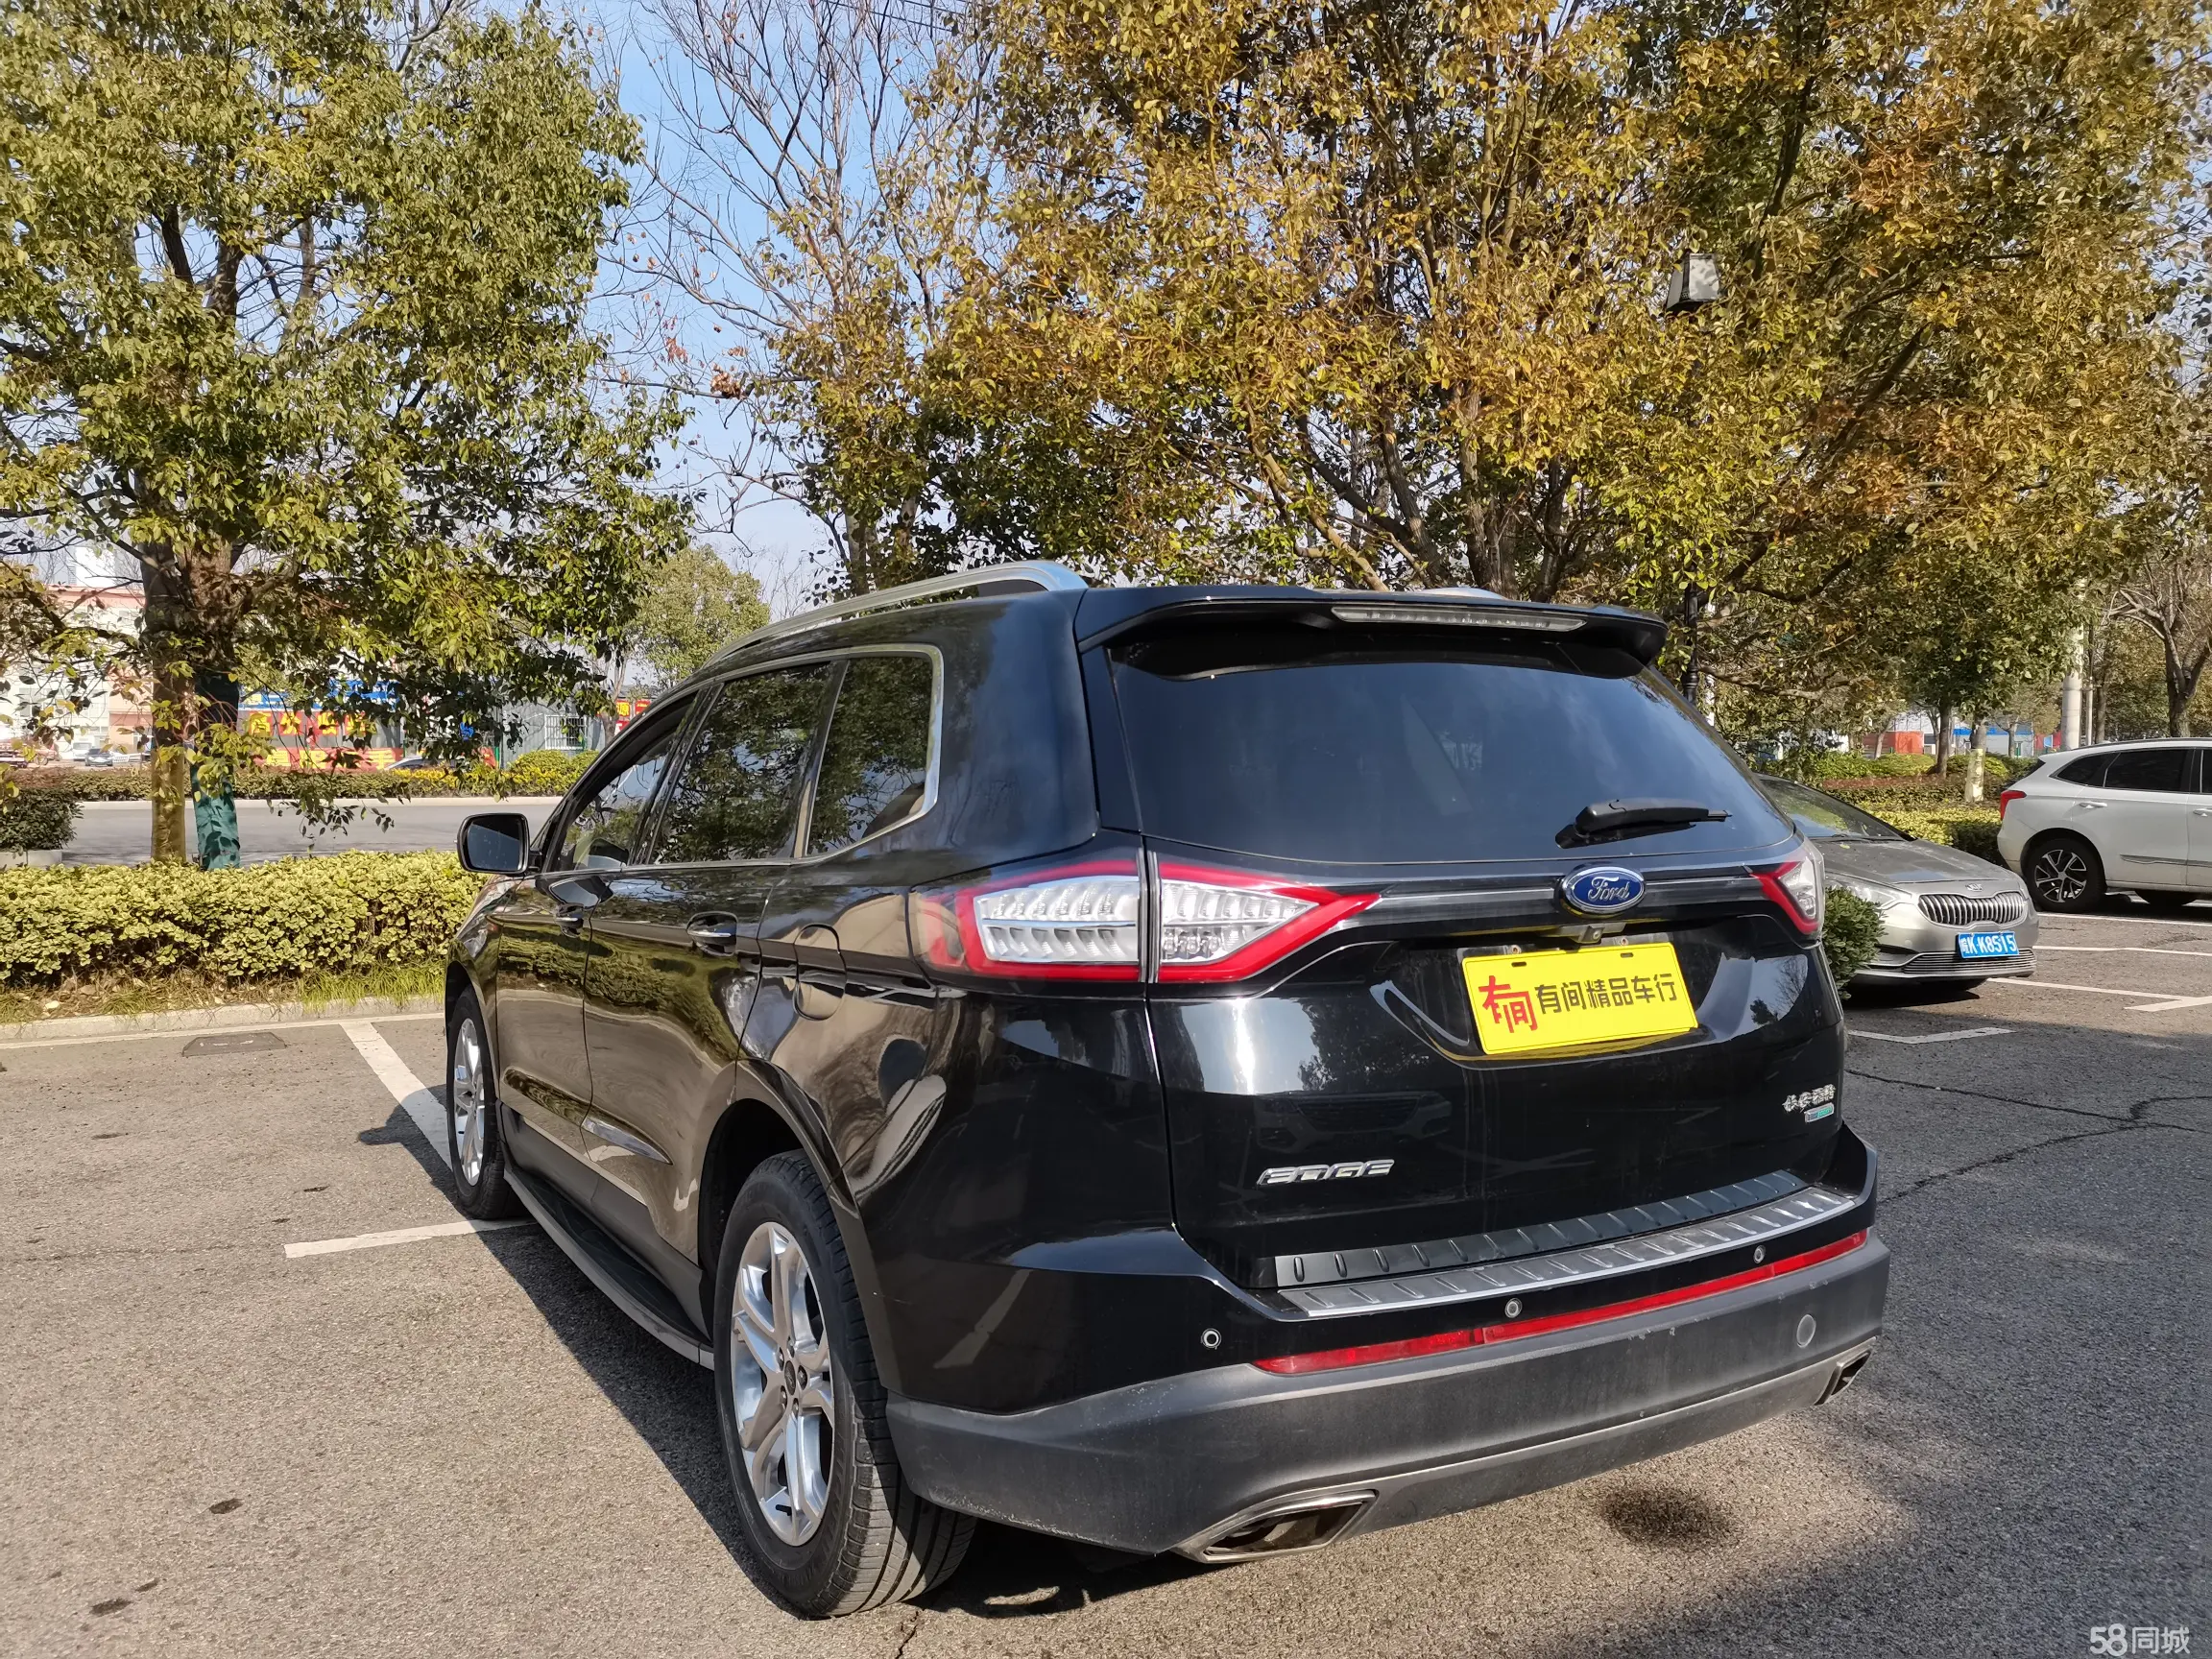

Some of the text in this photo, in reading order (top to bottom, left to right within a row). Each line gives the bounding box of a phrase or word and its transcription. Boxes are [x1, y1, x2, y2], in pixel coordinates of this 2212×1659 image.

[1587, 876, 1630, 902] Ford
[1534, 973, 1677, 1015] 有间精品车行
[1257, 1158, 1395, 1186] EDGE
